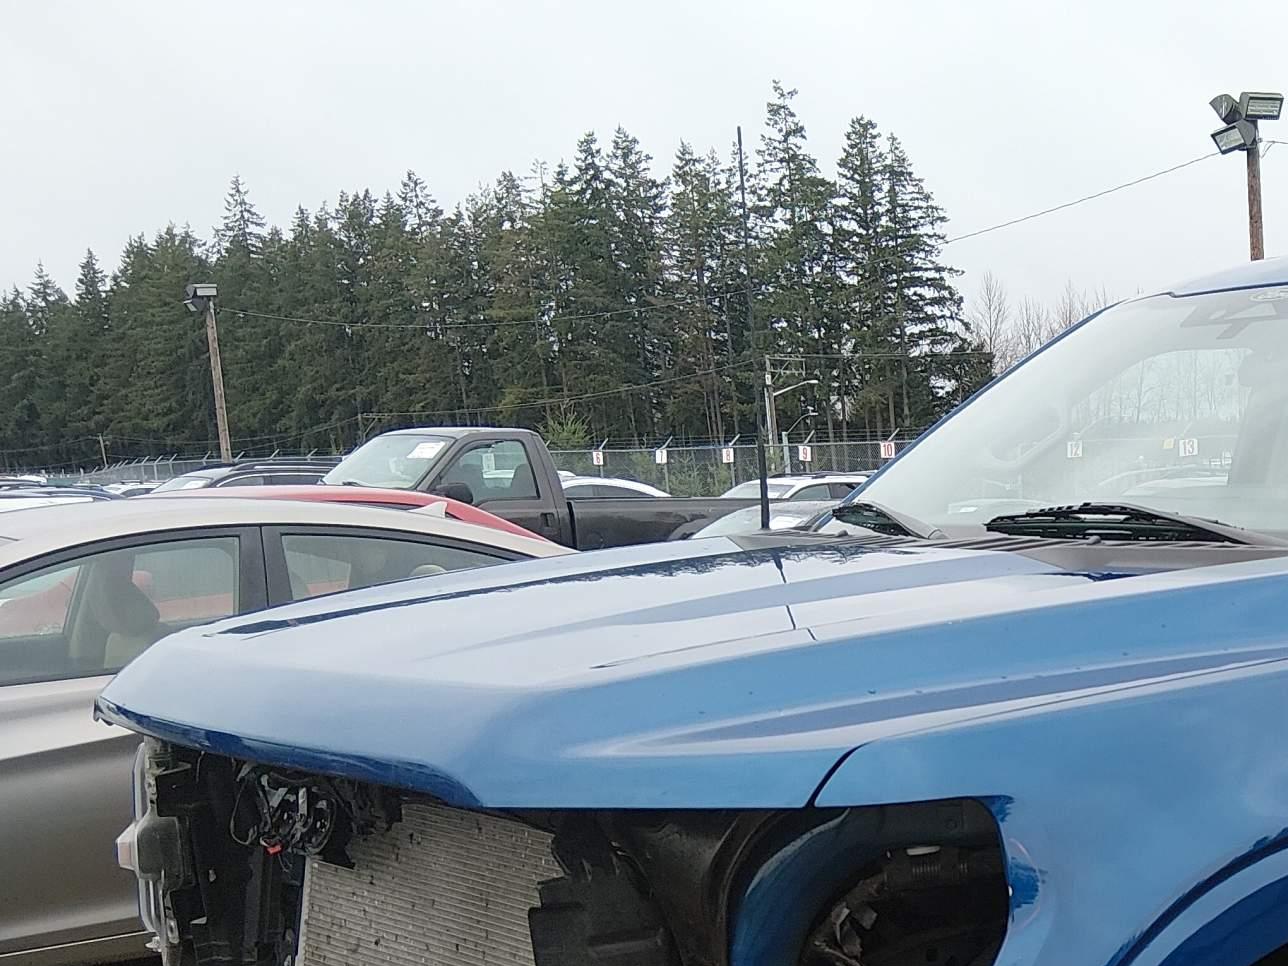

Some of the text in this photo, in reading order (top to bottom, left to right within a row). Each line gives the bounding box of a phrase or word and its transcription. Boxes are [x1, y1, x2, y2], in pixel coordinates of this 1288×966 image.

[802, 447, 808, 460] 9
[882, 443, 893, 457] 10
[1182, 439, 1195, 456] 13
